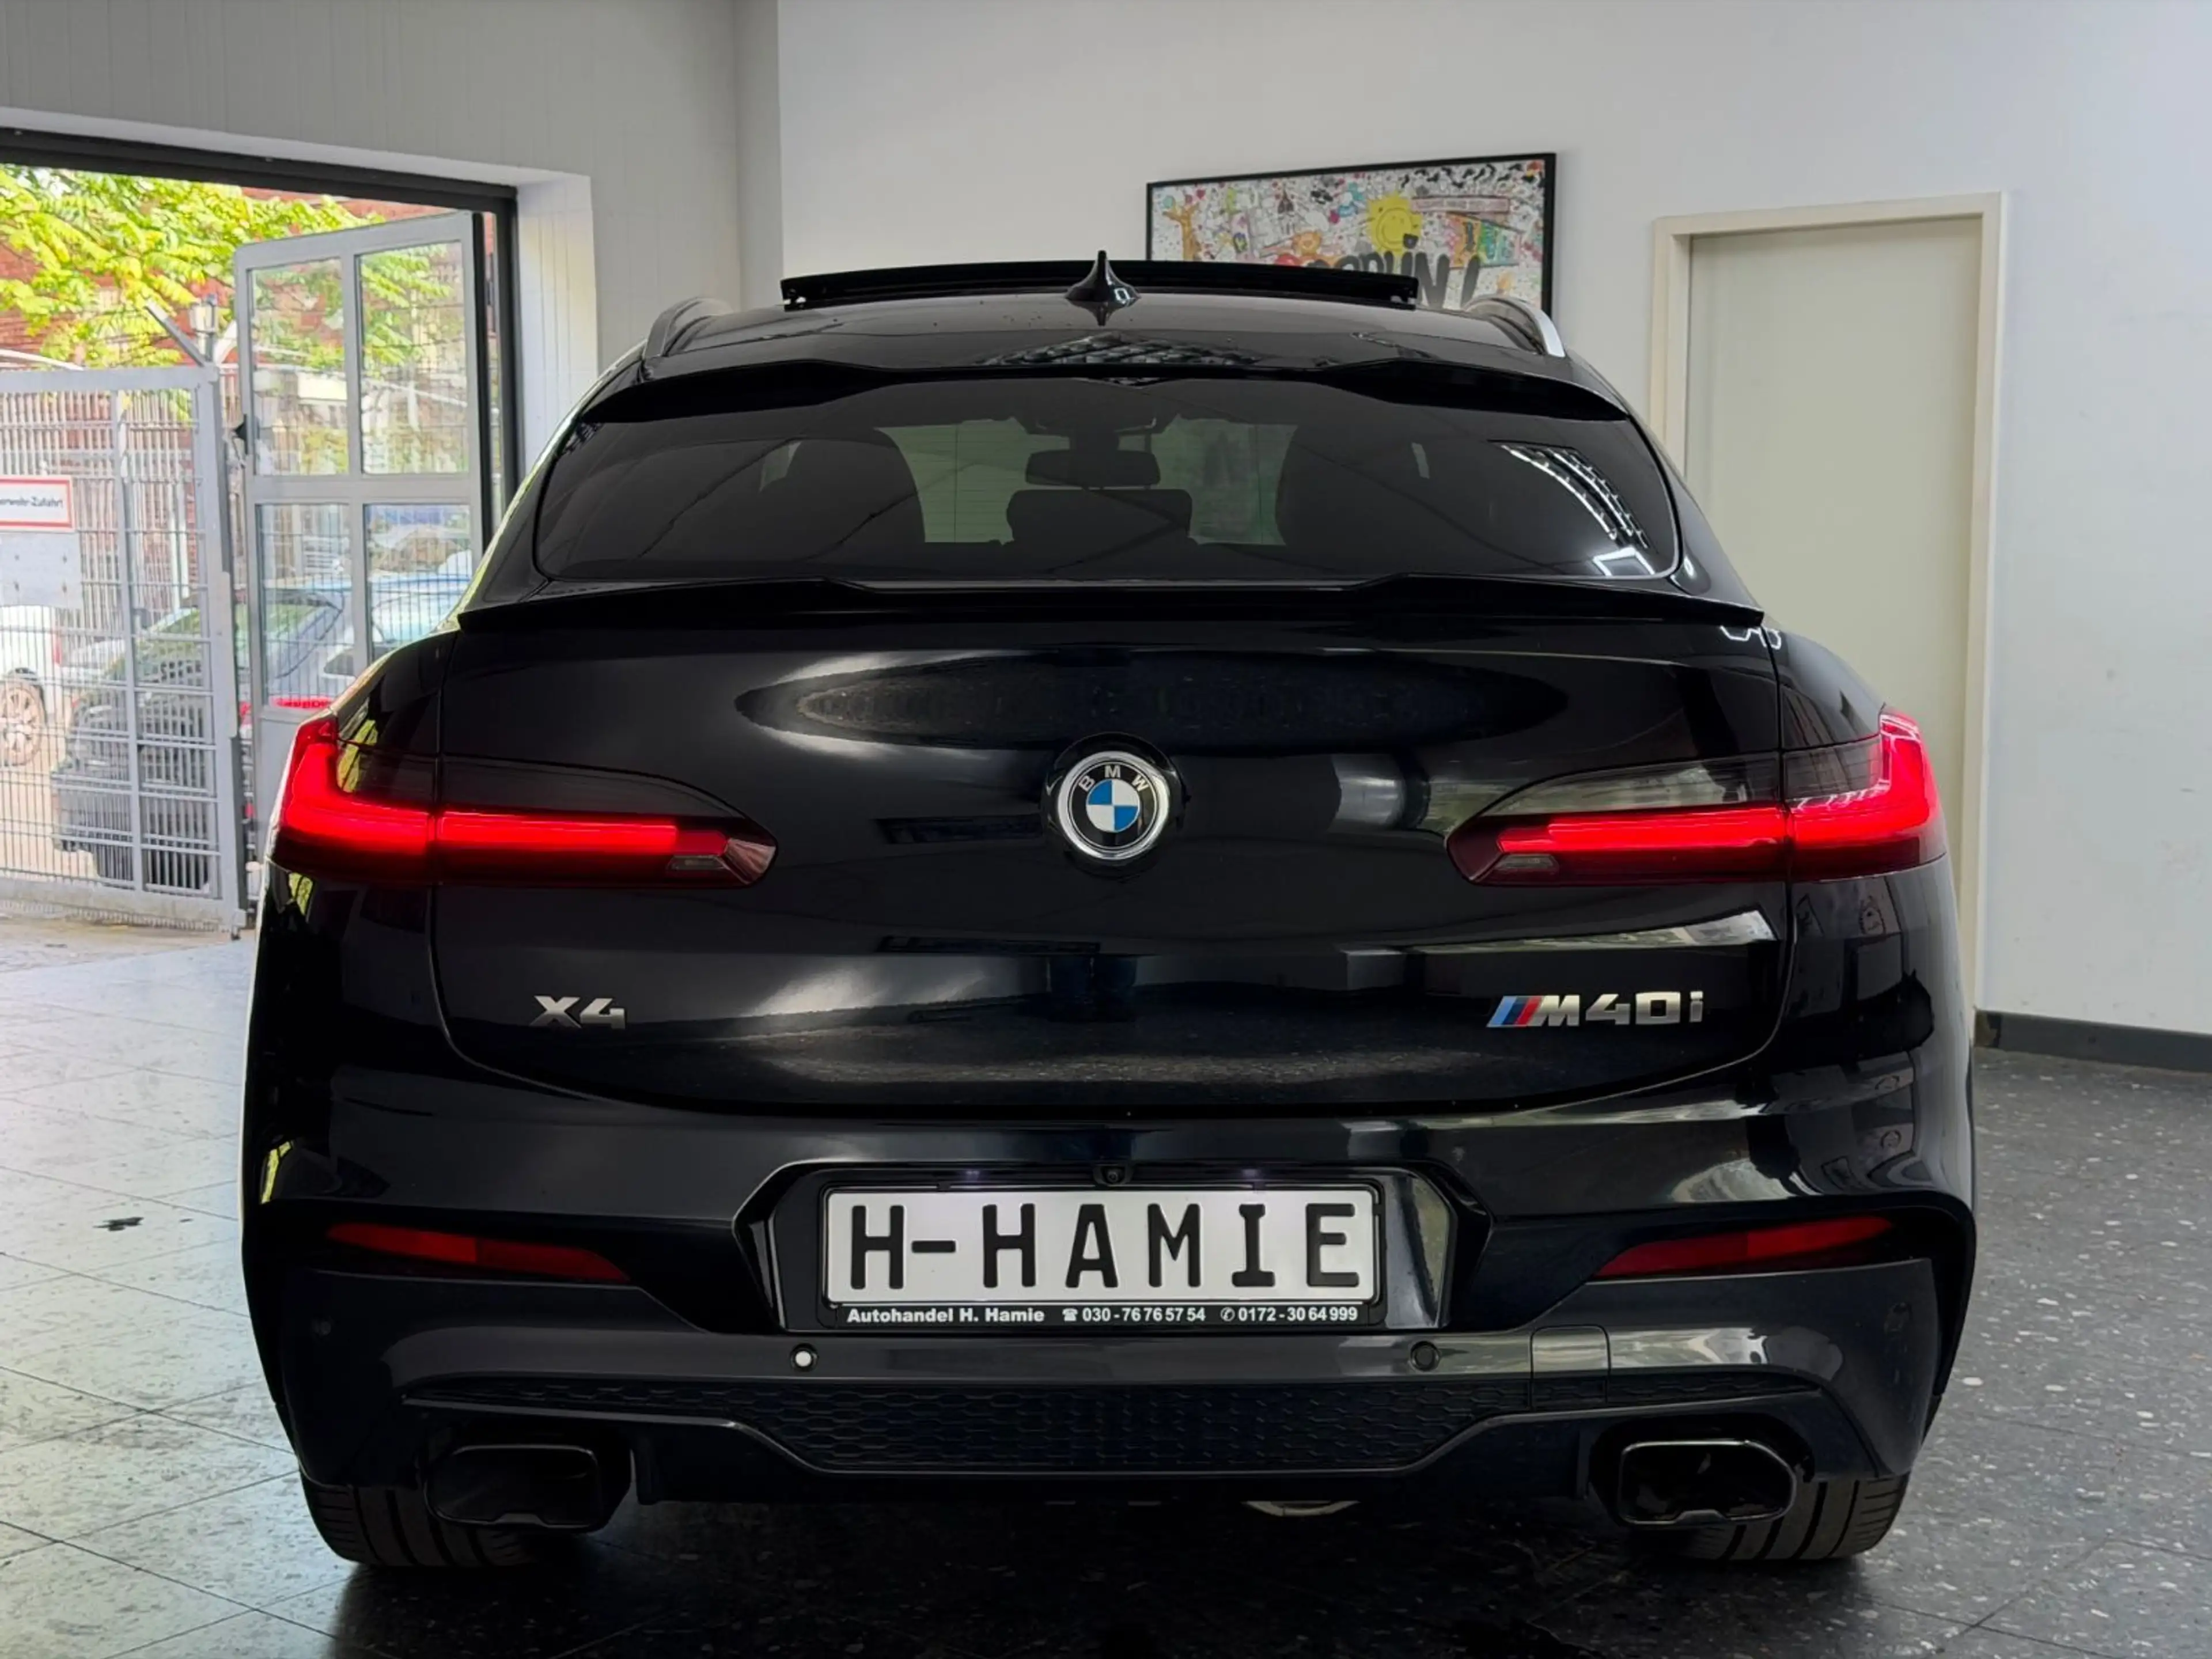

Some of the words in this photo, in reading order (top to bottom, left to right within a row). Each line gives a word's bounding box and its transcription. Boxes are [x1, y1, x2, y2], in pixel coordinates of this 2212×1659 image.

[1078, 765, 1150, 793] BMW
[529, 995, 626, 1029] X4
[1522, 991, 1703, 1027] M40i
[851, 1203, 1359, 1289] H-HAMIE
[847, 1308, 954, 1323] Autohandel
[959, 1308, 979, 1322] H.
[984, 1308, 1045, 1322] Hamie
